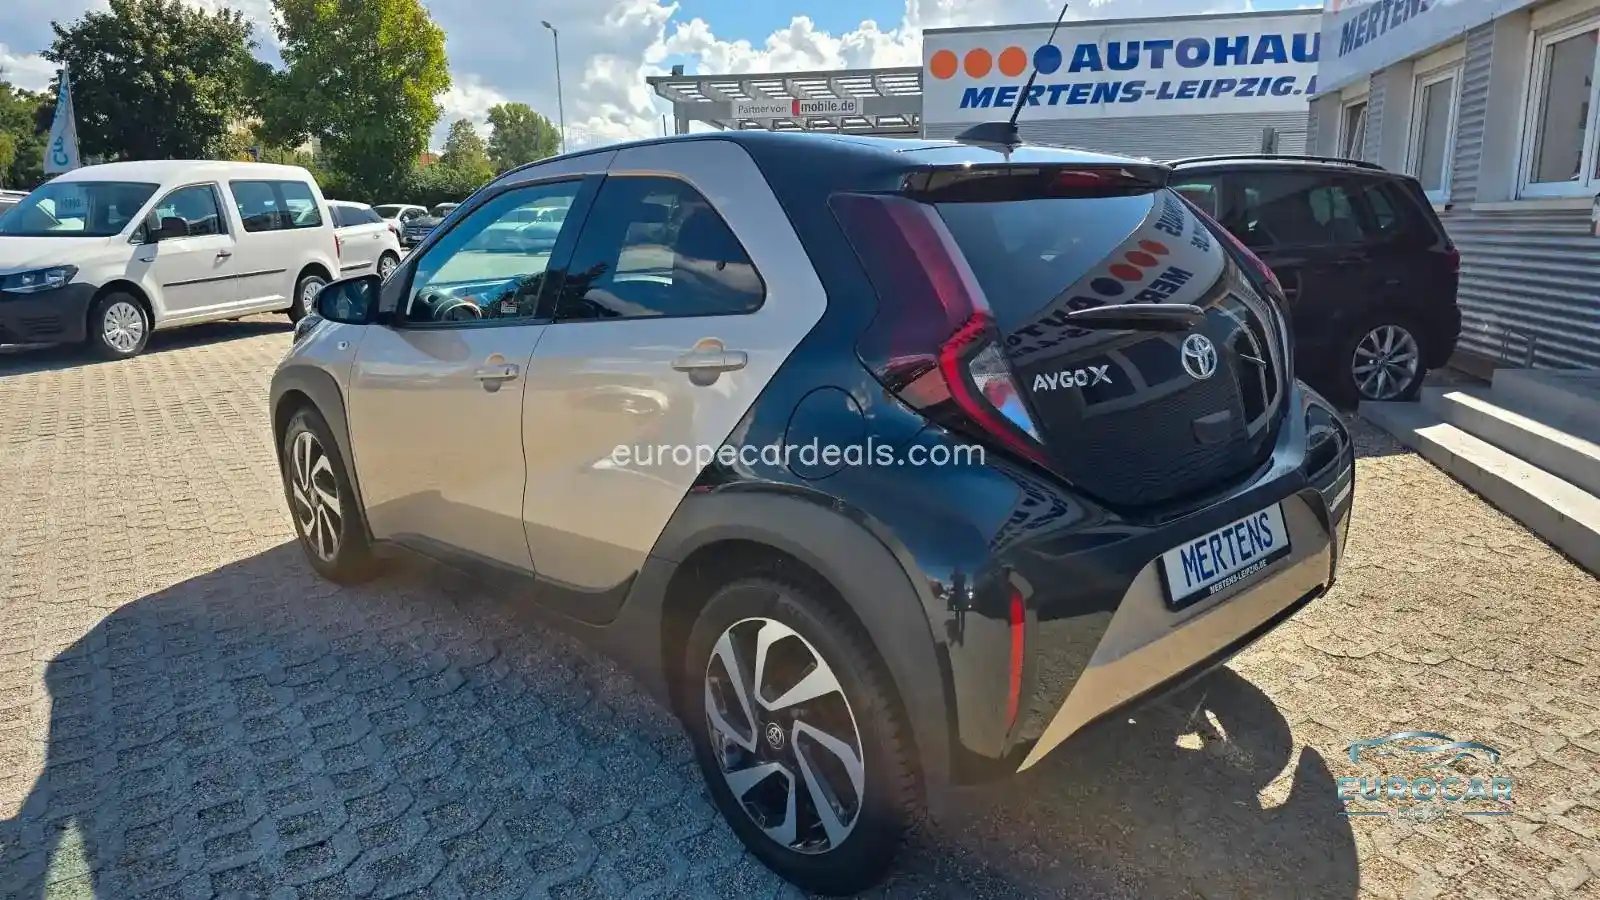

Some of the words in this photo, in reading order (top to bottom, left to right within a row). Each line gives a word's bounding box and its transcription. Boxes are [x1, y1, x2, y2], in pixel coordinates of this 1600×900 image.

[738, 105, 769, 114] Partner
[801, 101, 855, 112] mobile.de
[1180, 512, 1273, 587] MERTENS
[1209, 559, 1267, 594] MERTENS-LEIPZIG.DE
